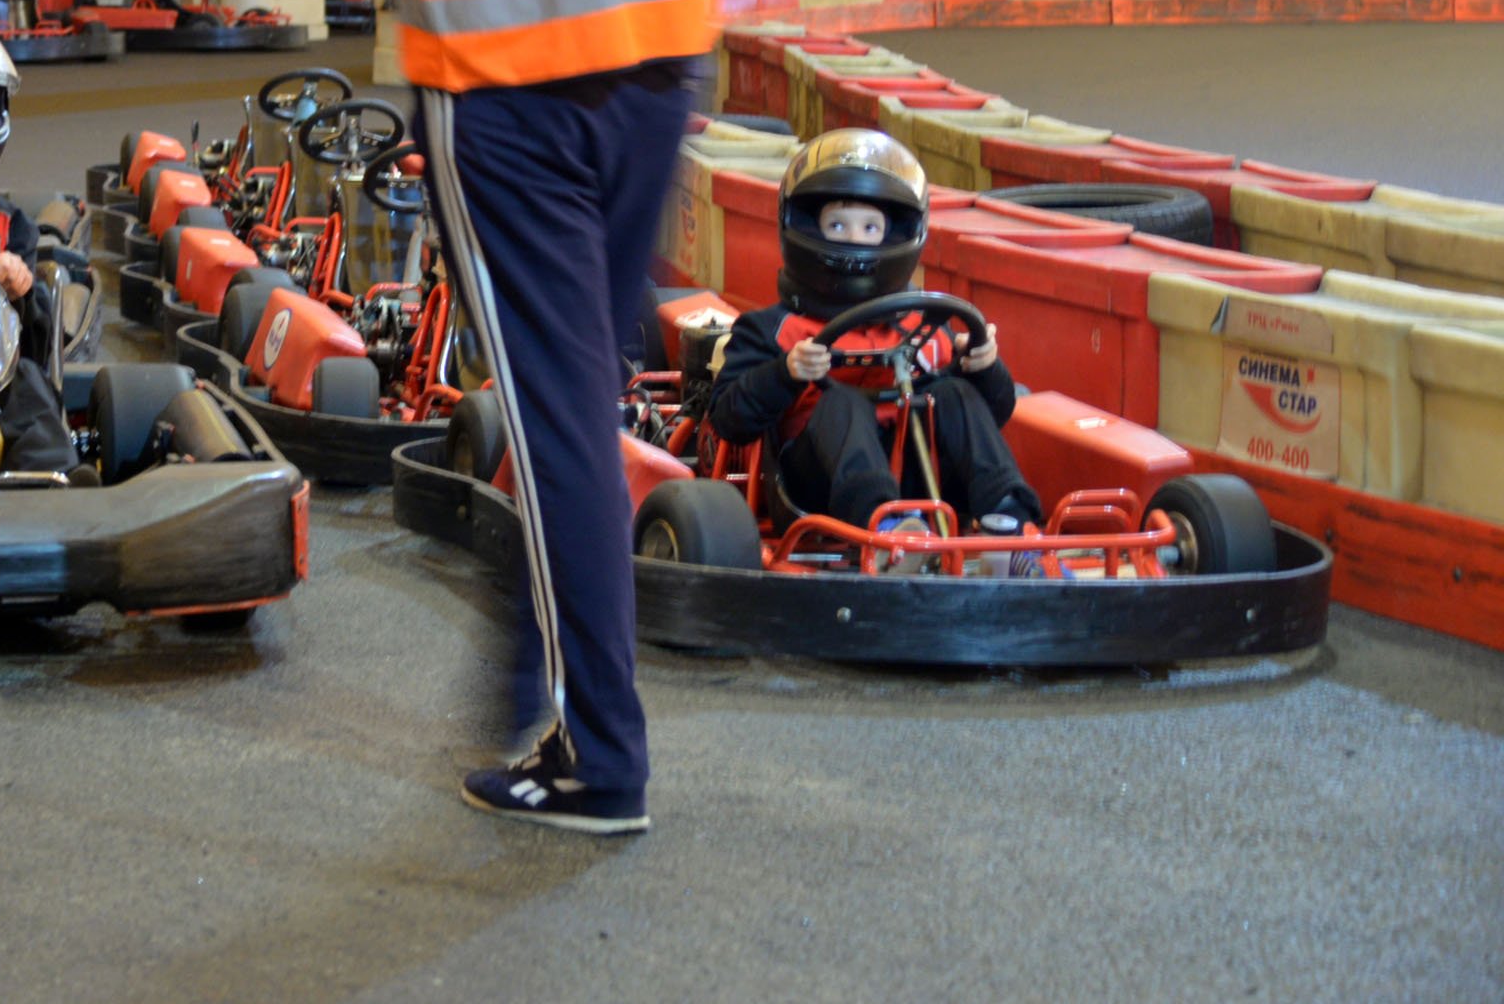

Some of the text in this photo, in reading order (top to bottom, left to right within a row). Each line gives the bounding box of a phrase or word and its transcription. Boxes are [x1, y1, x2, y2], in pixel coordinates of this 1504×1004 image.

[1238, 355, 1300, 387] СИНЕМА
[1278, 390, 1317, 416] СТАР
[1246, 436, 1310, 472] 400-400
